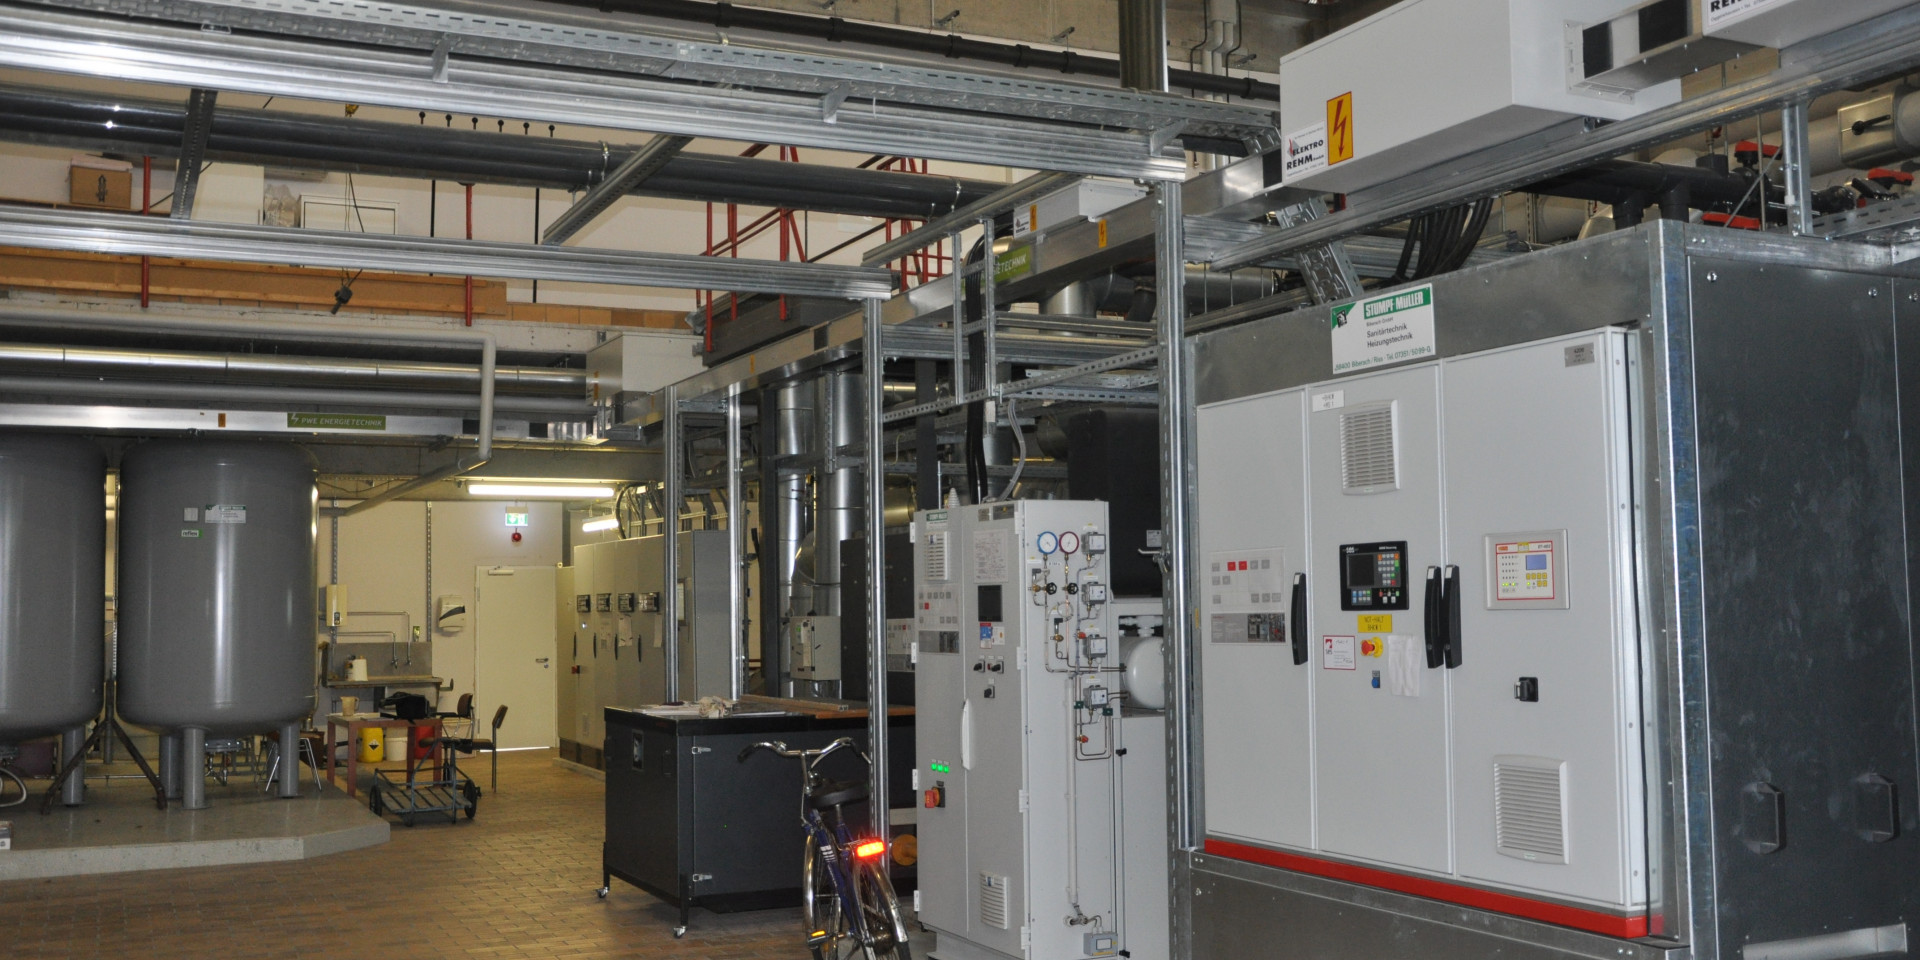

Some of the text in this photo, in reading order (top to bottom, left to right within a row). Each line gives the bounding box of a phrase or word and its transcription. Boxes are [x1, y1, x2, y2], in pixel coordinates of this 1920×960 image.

[1292, 139, 1324, 156] ELEKTRO
[1286, 154, 1313, 171] REHM
[1366, 323, 1408, 338] Sanitärtechnik
[1367, 332, 1413, 348] Heizungstechnik
[320, 417, 383, 426] ENERGIETECHNIK
